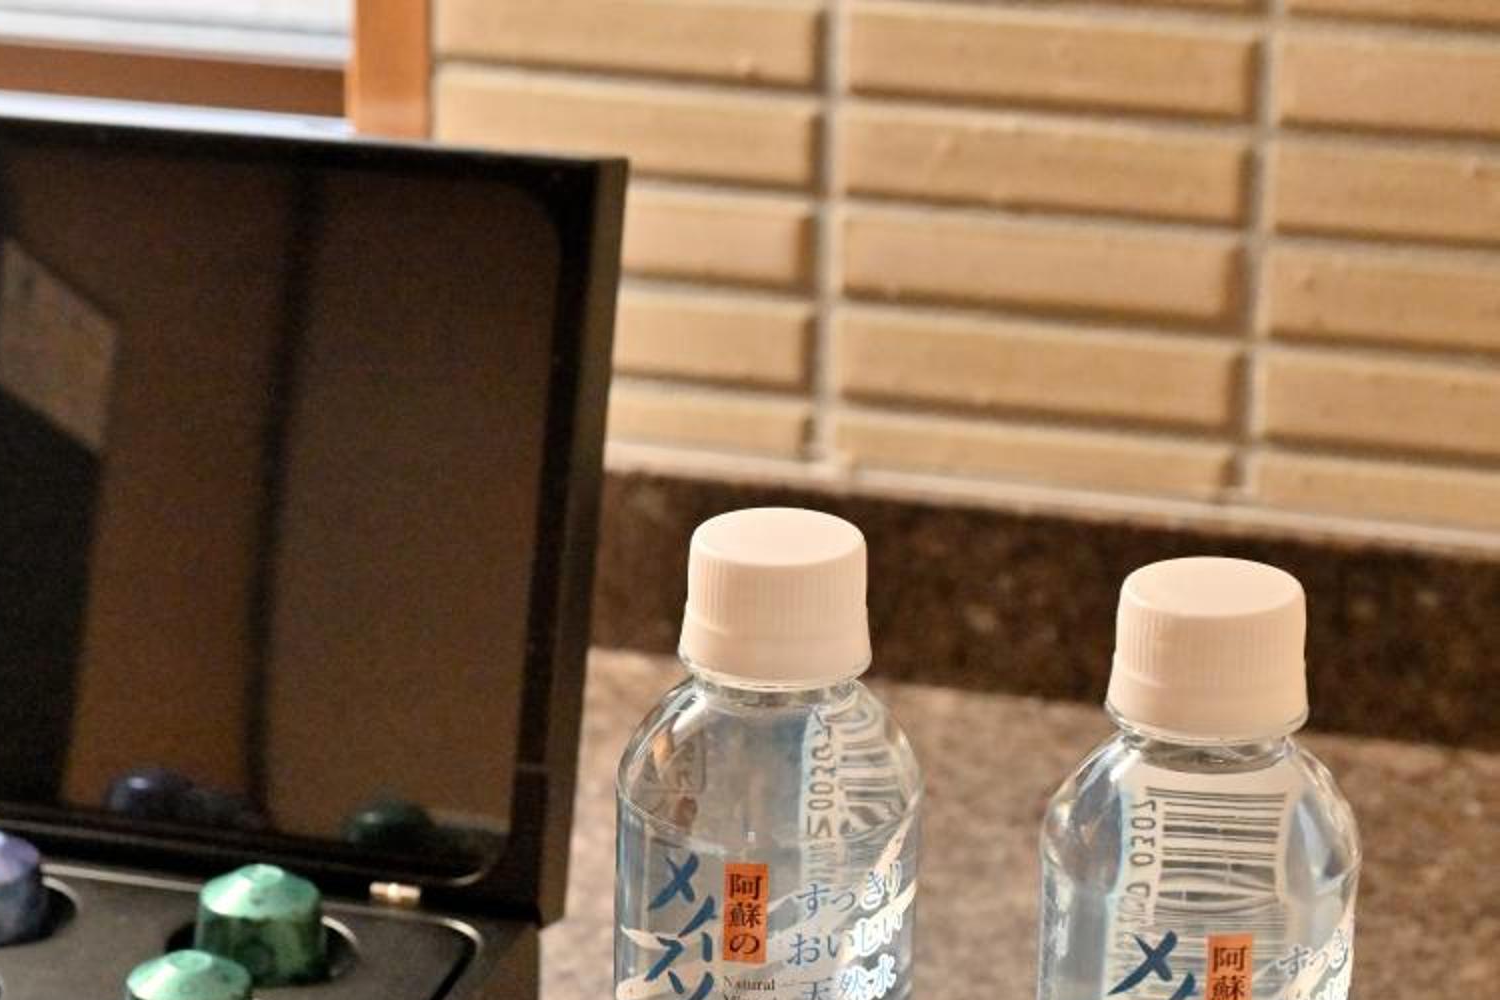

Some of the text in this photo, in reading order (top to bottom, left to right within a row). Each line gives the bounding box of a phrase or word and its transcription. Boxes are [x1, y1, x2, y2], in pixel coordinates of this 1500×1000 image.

[728, 873, 764, 956] 阿蘇の
[723, 976, 775, 991] Natural
